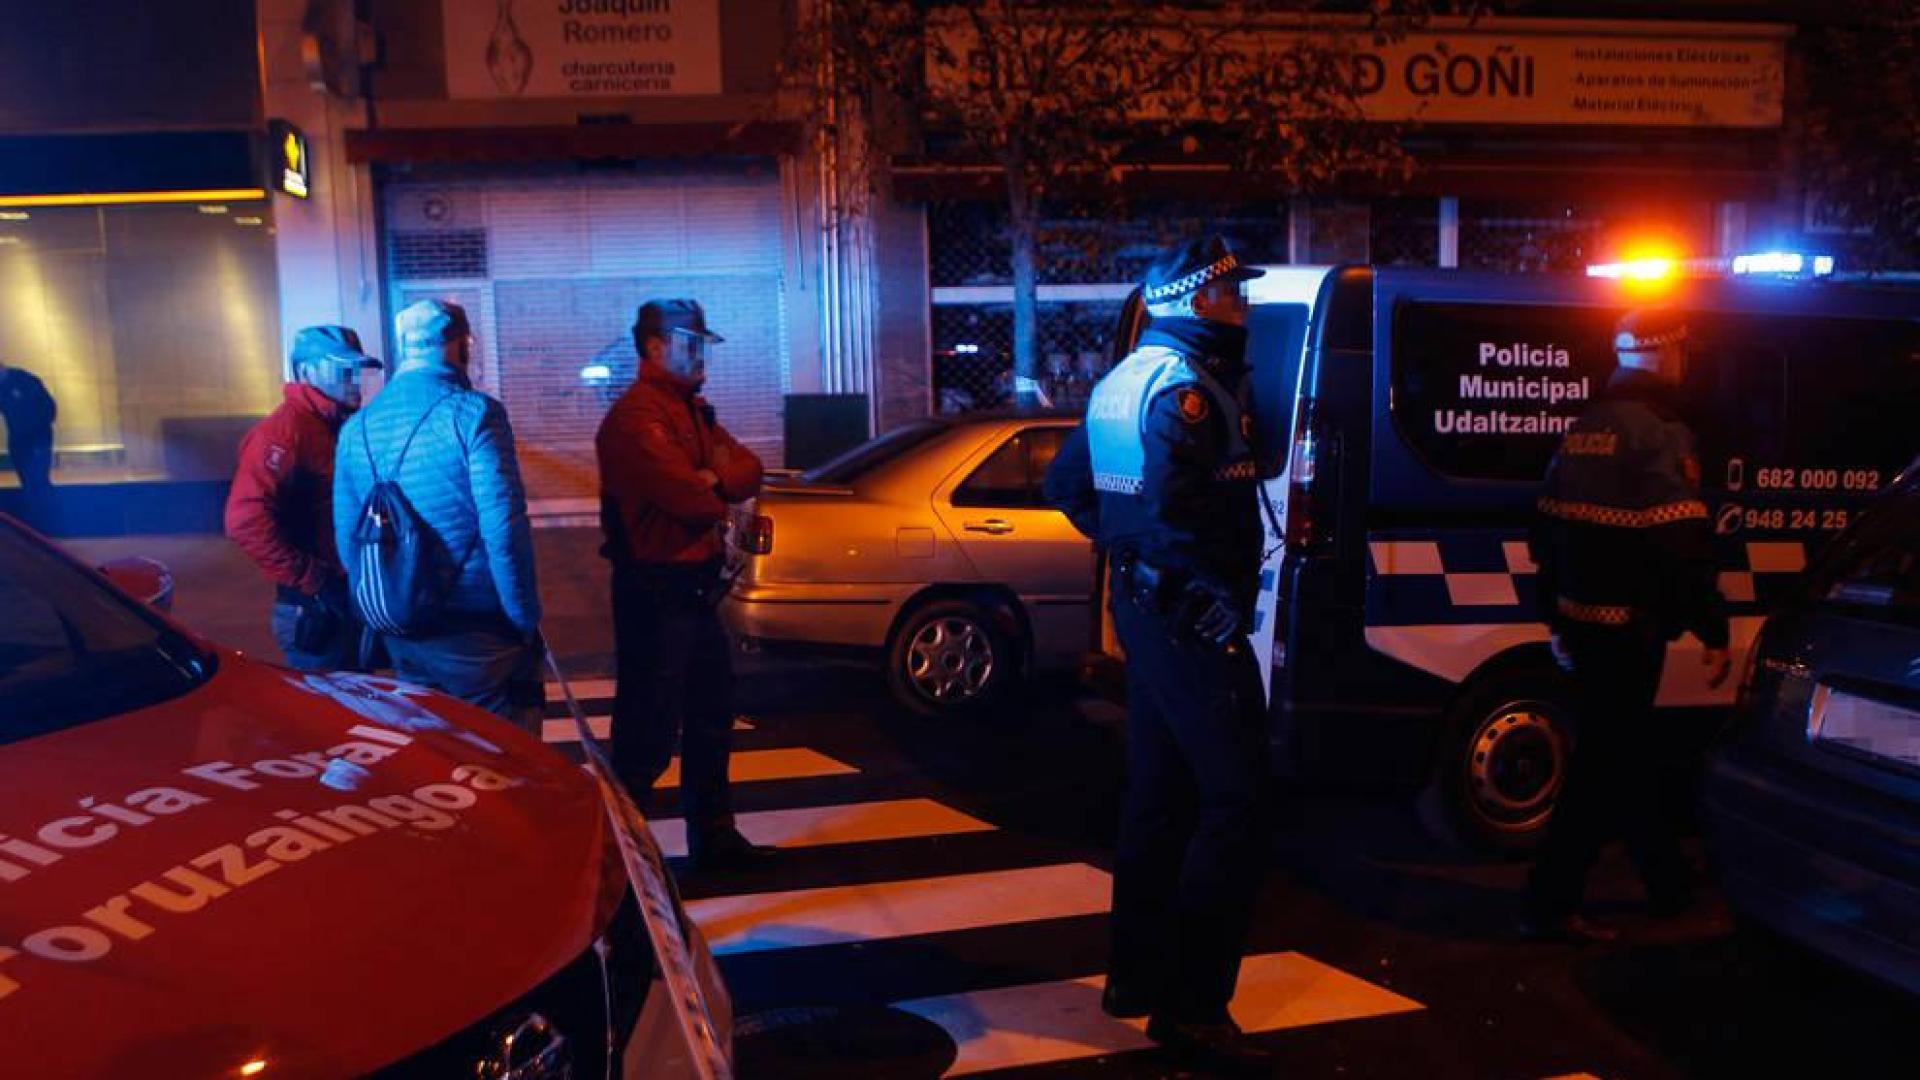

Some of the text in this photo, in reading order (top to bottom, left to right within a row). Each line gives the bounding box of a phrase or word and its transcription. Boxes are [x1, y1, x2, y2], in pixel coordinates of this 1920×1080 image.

[562, 19, 672, 43] Romero
[1404, 44, 1535, 97] GOÑI
[1478, 341, 1571, 368] Policía
[1458, 373, 1591, 404] Municipal
[1756, 467, 1880, 491] 682 000 092
[1744, 508, 1849, 530] 948 24 25
[0, 763, 522, 1000] oruzaingoa
